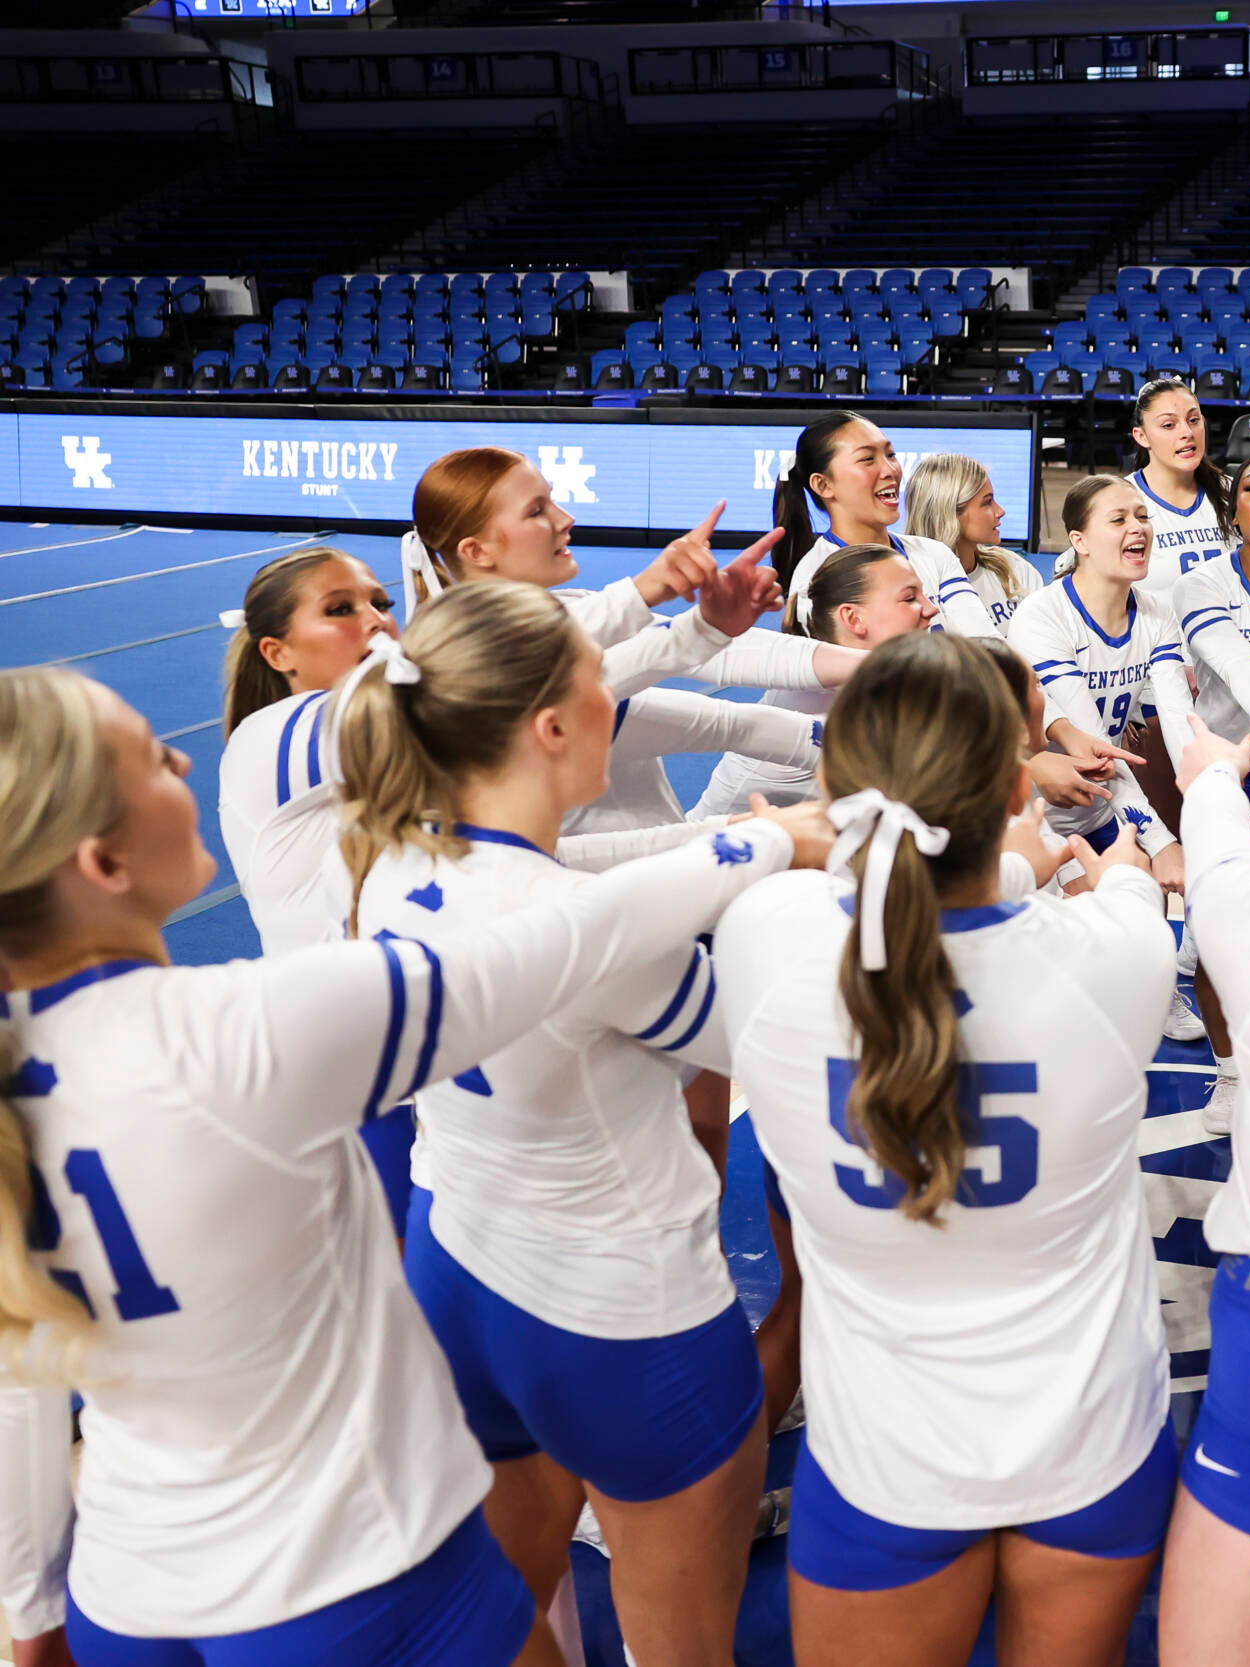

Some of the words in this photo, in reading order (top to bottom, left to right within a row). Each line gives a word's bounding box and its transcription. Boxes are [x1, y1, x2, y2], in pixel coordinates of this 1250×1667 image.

[1111, 41, 1133, 58] 16
[431, 61, 452, 78] 14
[765, 53, 786, 69] 15
[61, 435, 115, 488] UK
[242, 438, 399, 480] KENTUCKY
[537, 445, 599, 504] UK
[301, 482, 340, 496] STUNT
[1156, 526, 1225, 549] KENTUCK
